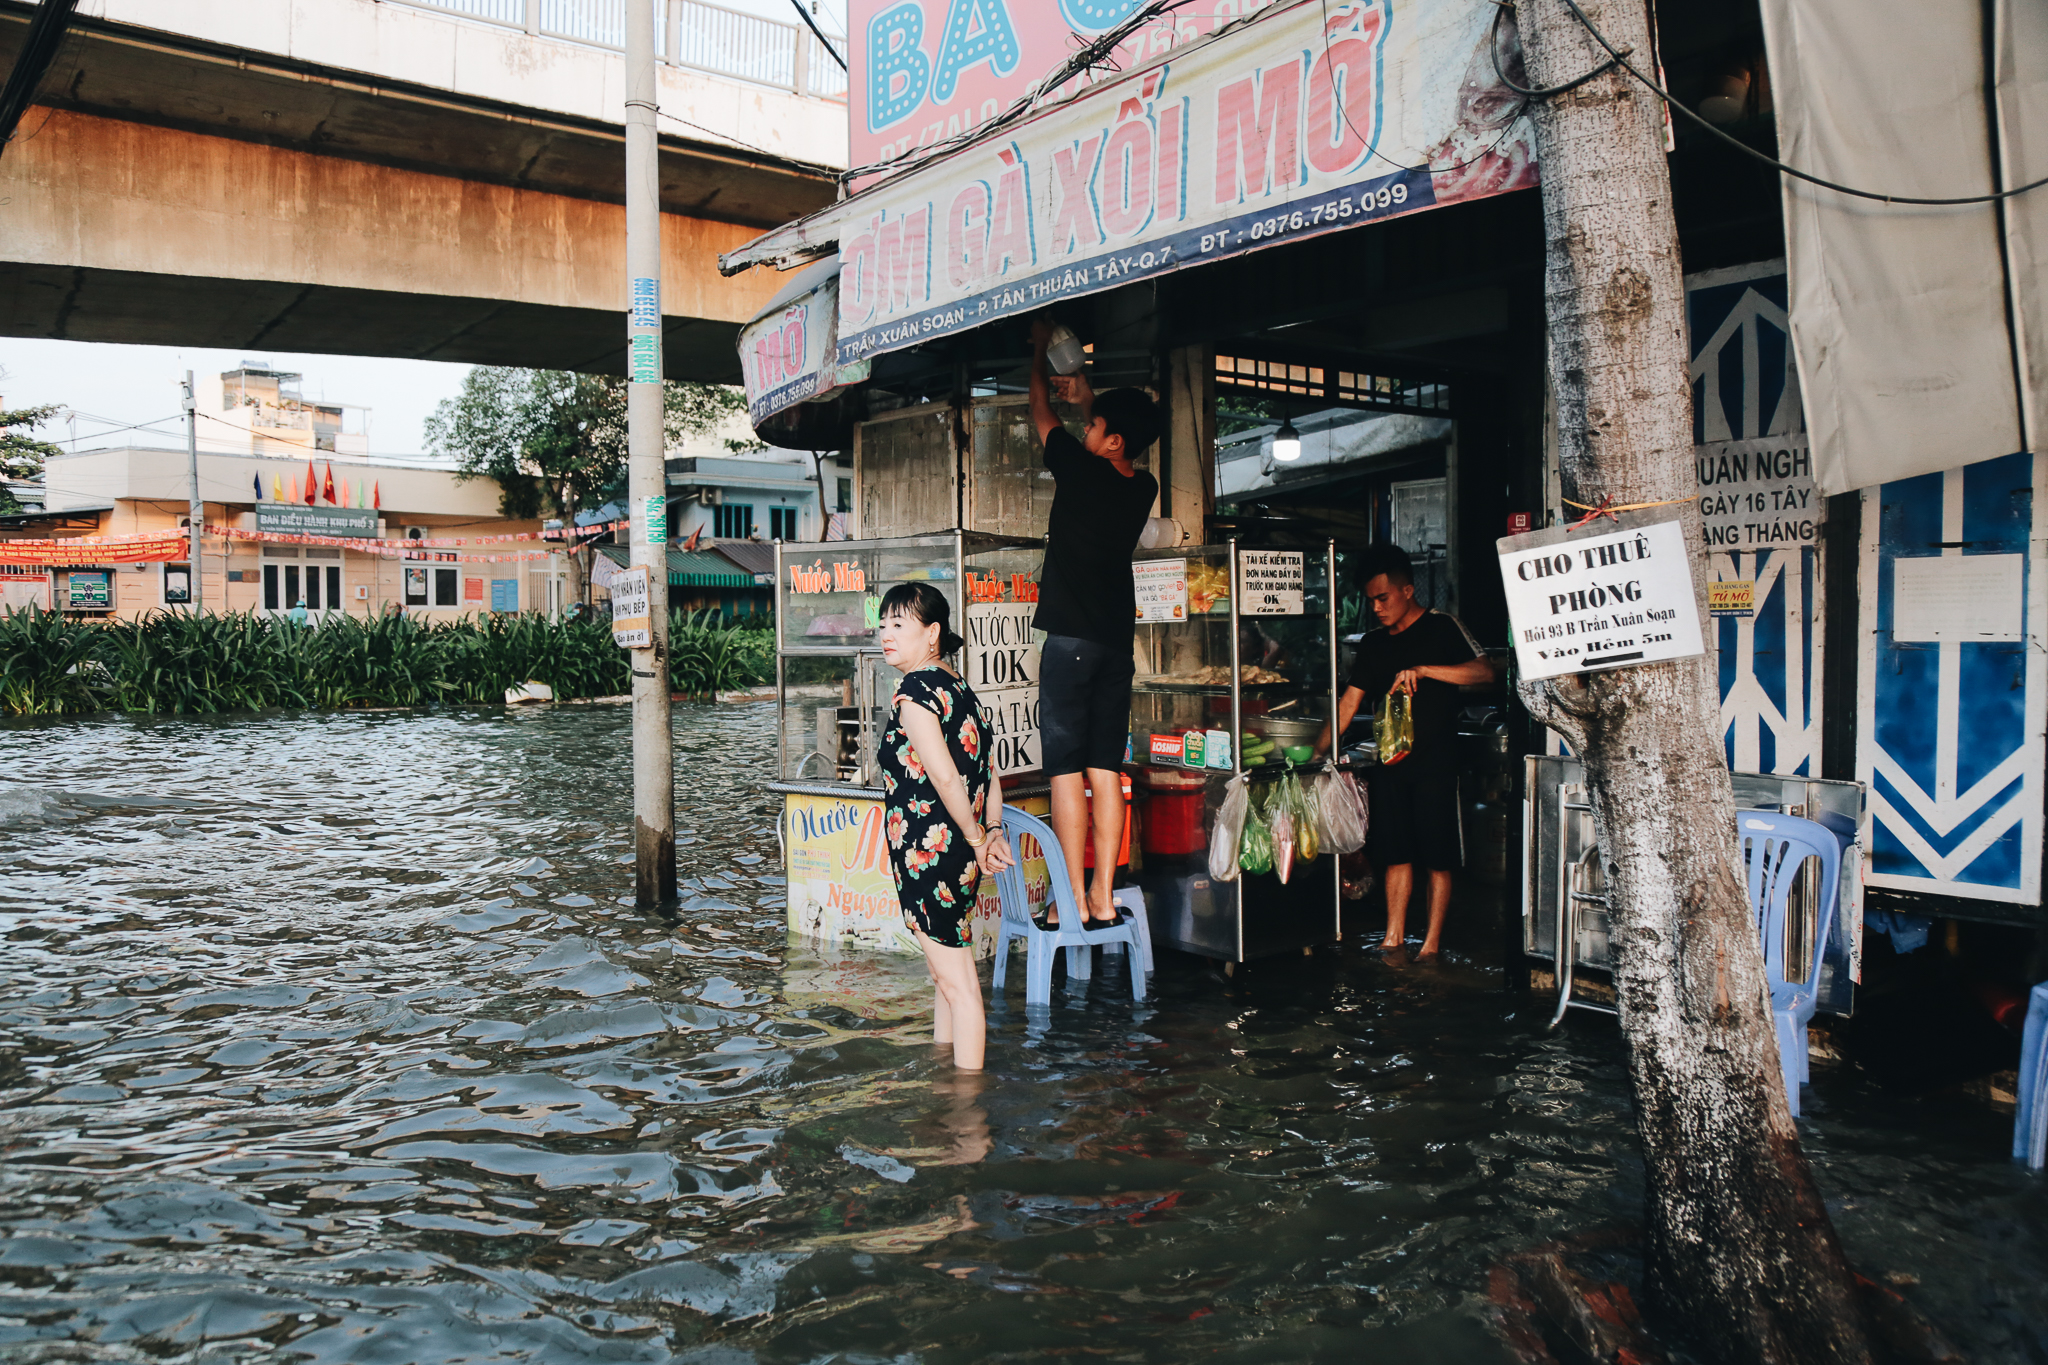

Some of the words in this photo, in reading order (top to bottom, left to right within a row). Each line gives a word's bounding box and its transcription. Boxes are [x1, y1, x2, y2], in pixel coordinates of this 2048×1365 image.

[838, 202, 933, 325] ƠM
[947, 141, 1037, 290] GÀ
[1049, 64, 1190, 254] XỐI
[1214, 0, 1393, 205] MỠ
[844, 332, 876, 358] TRẦN
[880, 322, 919, 345] XUÂN
[923, 308, 964, 332] SOẠN
[979, 301, 988, 316] P.
[992, 288, 1025, 310] TÂN
[1030, 269, 1089, 299] THUẬN
[1200, 229, 1230, 253] ĐT
[1251, 183, 1408, 240] 0376.755.099
[756, 304, 808, 391] MỠ
[770, 378, 815, 409] 0376.755.099
[1695, 447, 1748, 487] UÁN
[1756, 447, 1813, 481] NGH
[1700, 490, 1740, 516] GÀY
[1745, 492, 1765, 513] 16
[1770, 484, 1811, 511] TÂY
[260, 514, 279, 524] BAN
[304, 514, 328, 528] HÀNH
[329, 517, 347, 528] KHU
[349, 515, 367, 529] PHỐ
[368, 520, 374, 529] 3
[1702, 522, 1739, 546] ÀNG
[1744, 516, 1814, 544] THÁNG
[1246, 553, 1257, 565] TÀI
[1270, 552, 1287, 565] KIỂM
[1288, 556, 1301, 566] TRA
[1261, 567, 1277, 578] HÀNG
[1517, 553, 1573, 582] CHO
[1579, 532, 1652, 571] THUÊ
[790, 559, 832, 594] Nước
[834, 561, 865, 592] Mía
[965, 569, 1005, 603] Nước
[1011, 571, 1039, 603] Mía
[1275, 582, 1287, 591] GIAO
[1288, 580, 1303, 591] HÀNG
[633, 597, 646, 614] BẾP
[1548, 579, 1643, 616] PHÒNG
[969, 607, 1010, 647] NƯỚC
[1014, 606, 1035, 645] MÍ
[1523, 625, 1546, 643] Hỏi
[1548, 624, 1564, 639] 93
[1567, 622, 1576, 636] B
[1577, 614, 1609, 634] Trần
[1611, 611, 1644, 628] Xuân
[1646, 607, 1677, 625] Soạn
[1537, 644, 1579, 661] Vào
[1641, 631, 1674, 645] 5m
[979, 648, 1031, 684] 10K
[984, 694, 1007, 736] RÀ
[997, 734, 1035, 770] 0K
[1152, 741, 1182, 754] LOSHIP
[792, 800, 861, 842] Nước
[828, 883, 900, 920] Nguyên
[975, 893, 1002, 921] Nguy
